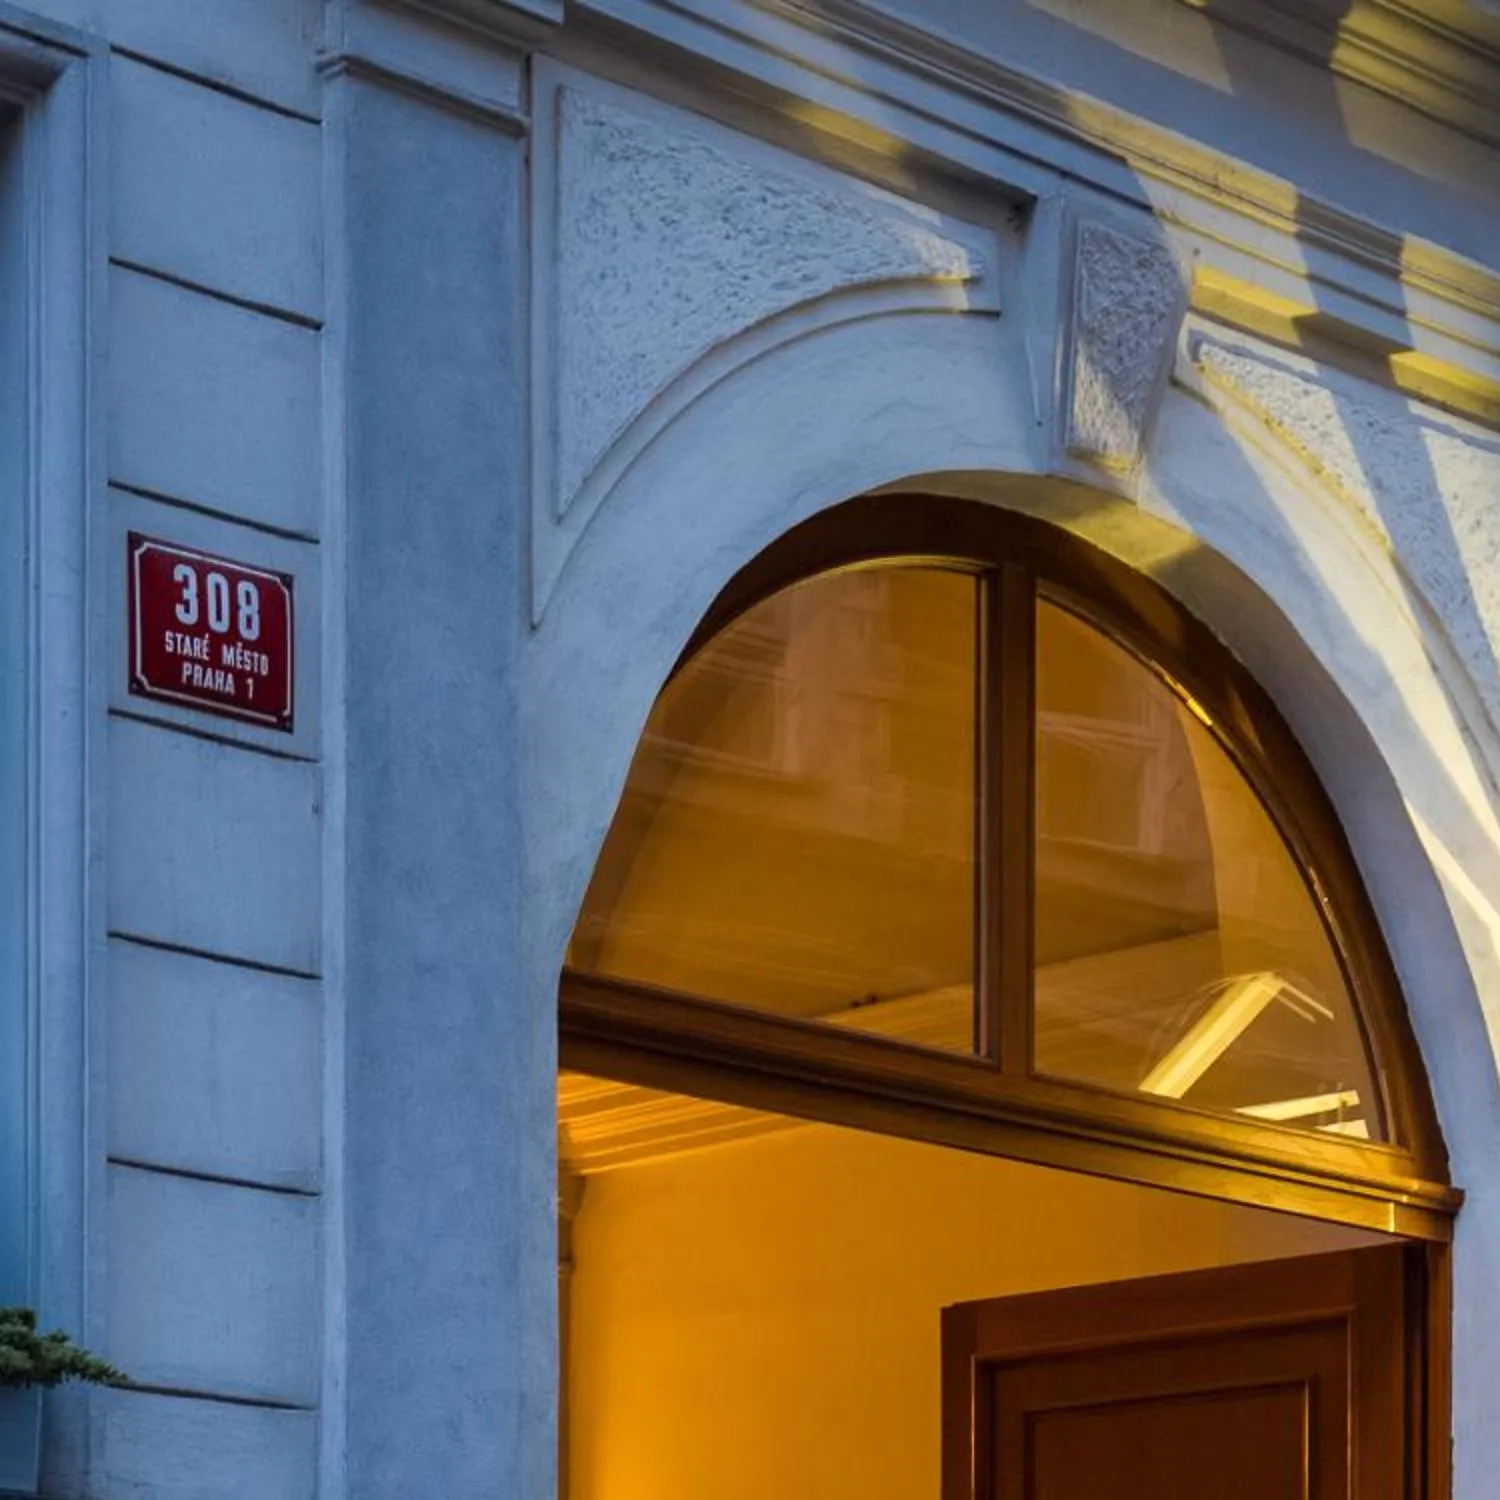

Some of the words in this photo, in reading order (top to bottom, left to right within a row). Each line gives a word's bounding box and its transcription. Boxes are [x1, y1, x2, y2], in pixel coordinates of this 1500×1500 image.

[173, 565, 260, 640] 308
[165, 631, 210, 661] STARÉ
[222, 643, 269, 676] MĚSTO
[182, 663, 235, 696] PRAHA
[246, 678, 254, 699] 1
